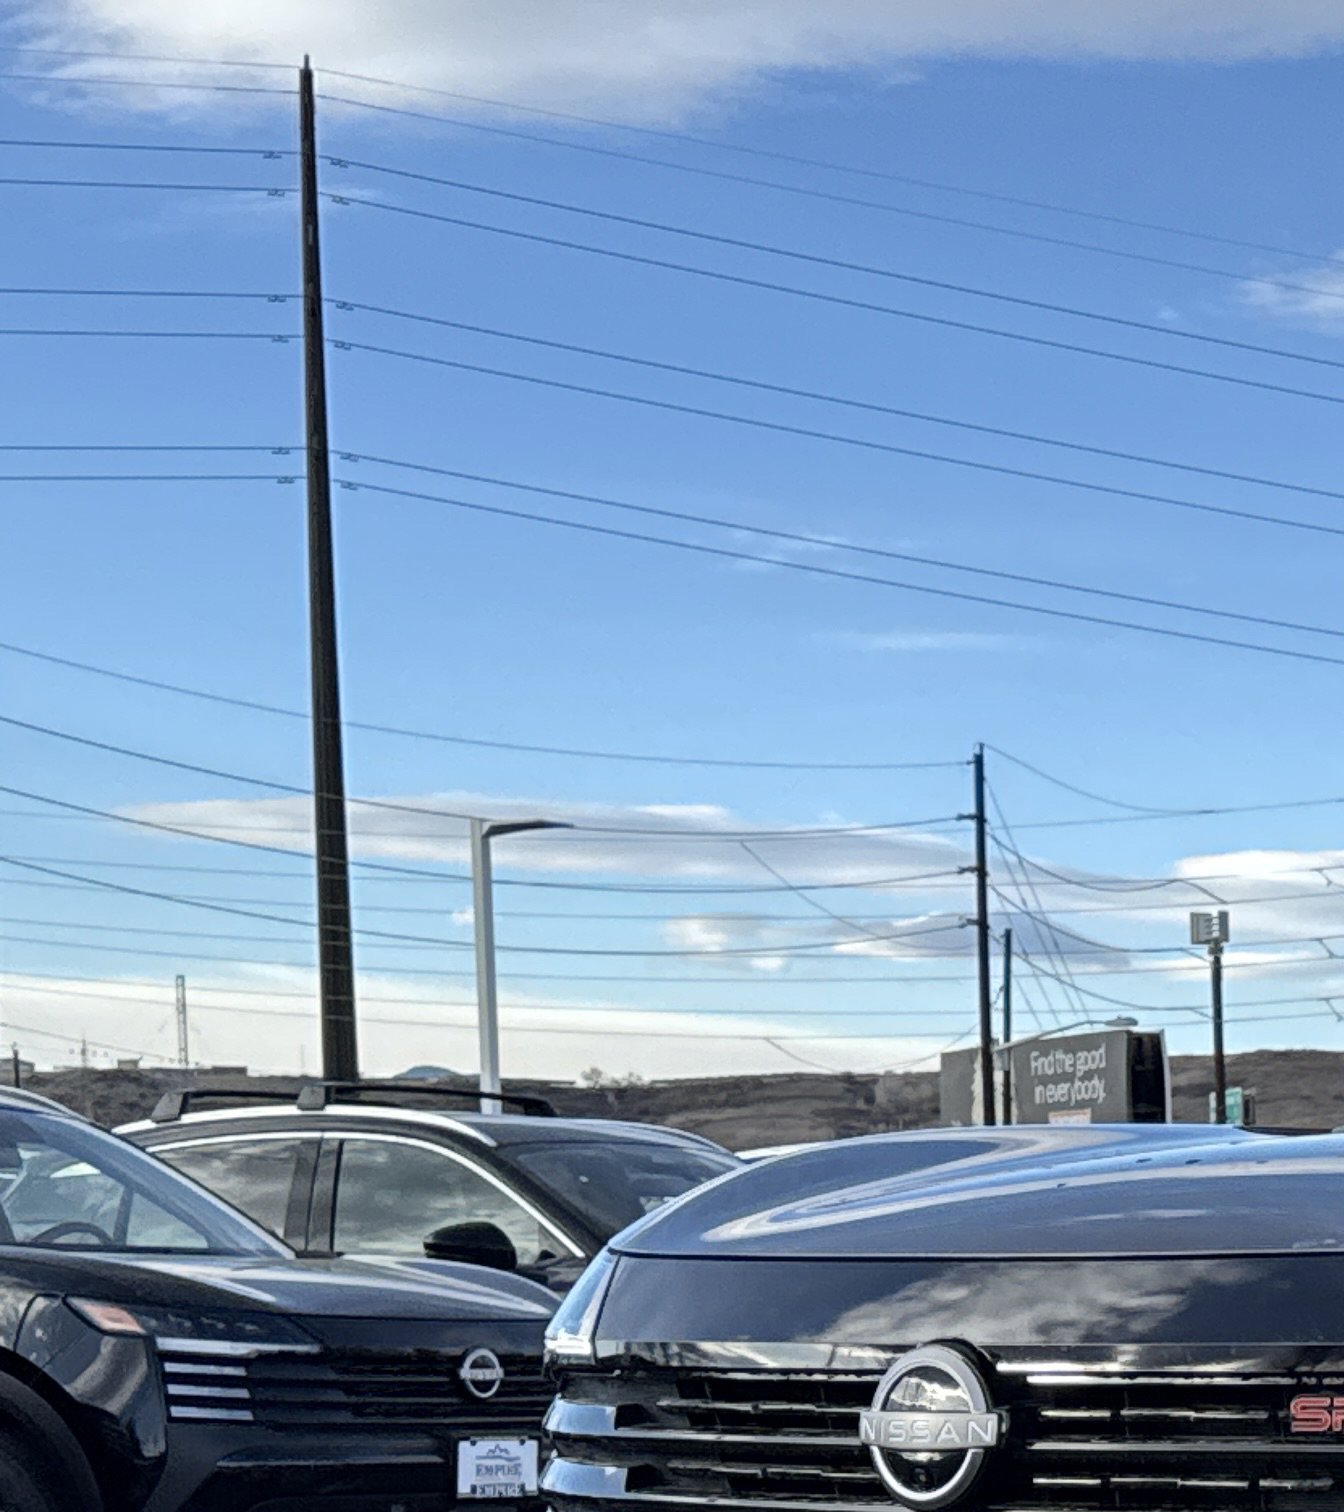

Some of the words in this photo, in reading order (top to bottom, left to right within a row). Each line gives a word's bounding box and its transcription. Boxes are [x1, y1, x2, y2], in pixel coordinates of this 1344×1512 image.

[1030, 1049, 1055, 1076] Find
[1055, 1048, 1075, 1074] the
[1075, 1042, 1106, 1077] good
[1033, 1078, 1045, 1104] in
[860, 1418, 994, 1443] NISSAN
